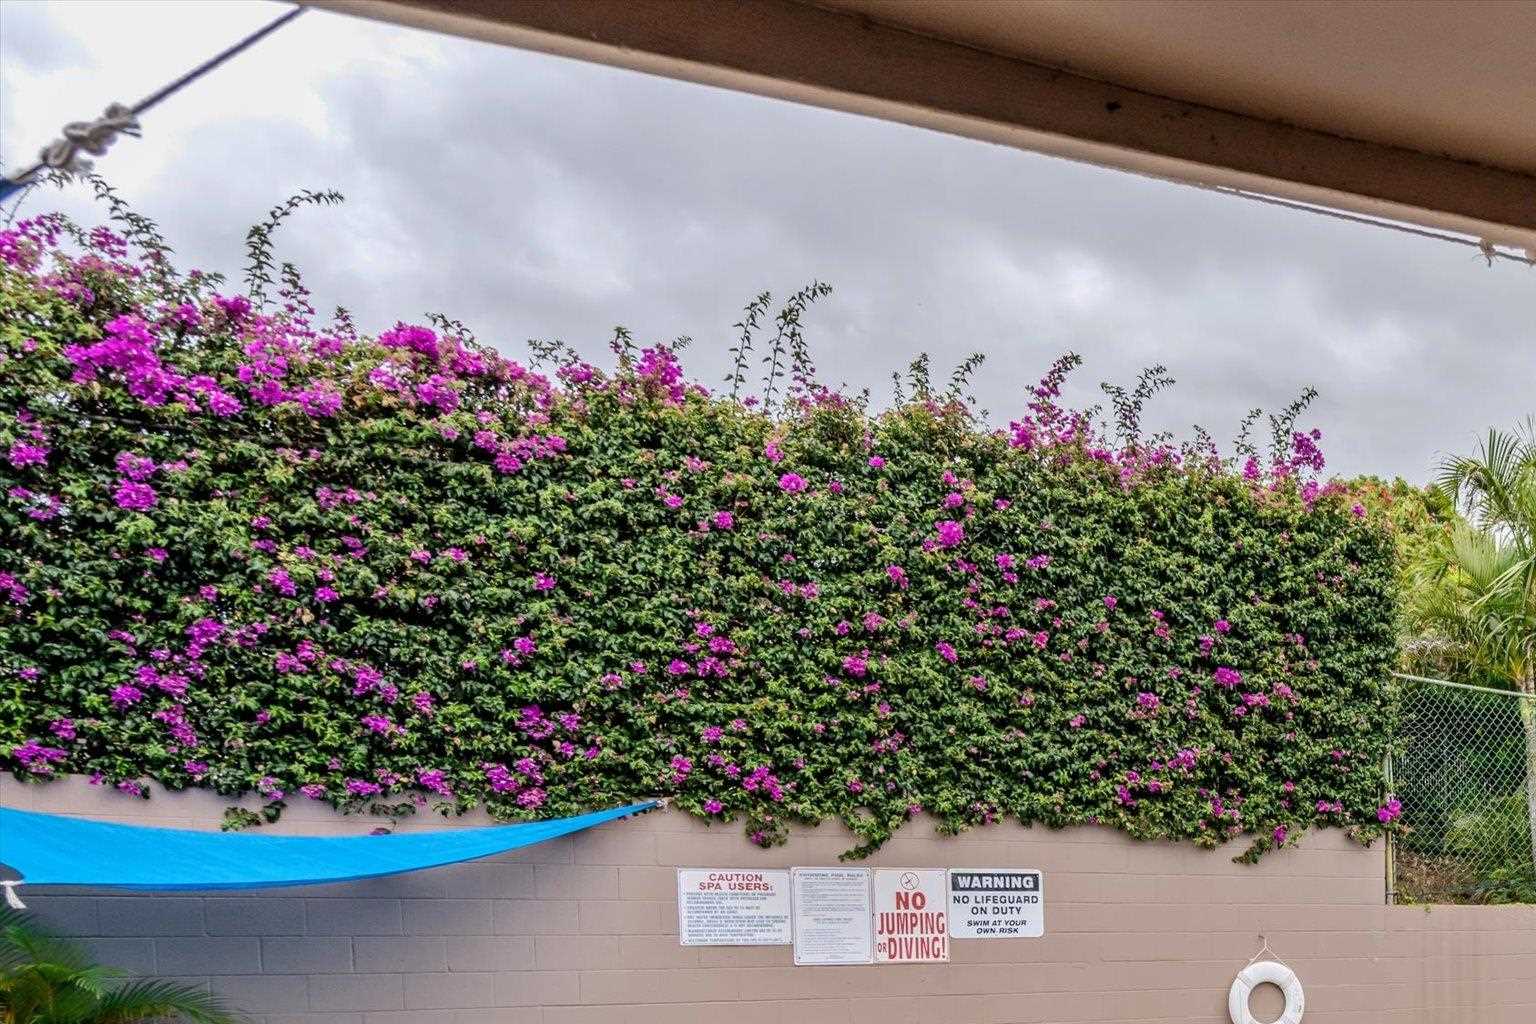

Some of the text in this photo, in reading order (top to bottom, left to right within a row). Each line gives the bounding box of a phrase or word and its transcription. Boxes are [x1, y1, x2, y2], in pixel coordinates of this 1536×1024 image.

[709, 873, 763, 882] CAUTION
[957, 875, 1034, 889] WARNING
[699, 882, 722, 891] SPA
[895, 891, 926, 910] NO
[953, 895, 1039, 904] NO LIFEGUARD
[971, 906, 1022, 915] ON DUTY
[878, 912, 945, 935] JUMPING
[877, 942, 887, 953] OR
[888, 936, 946, 959] DIVING!
